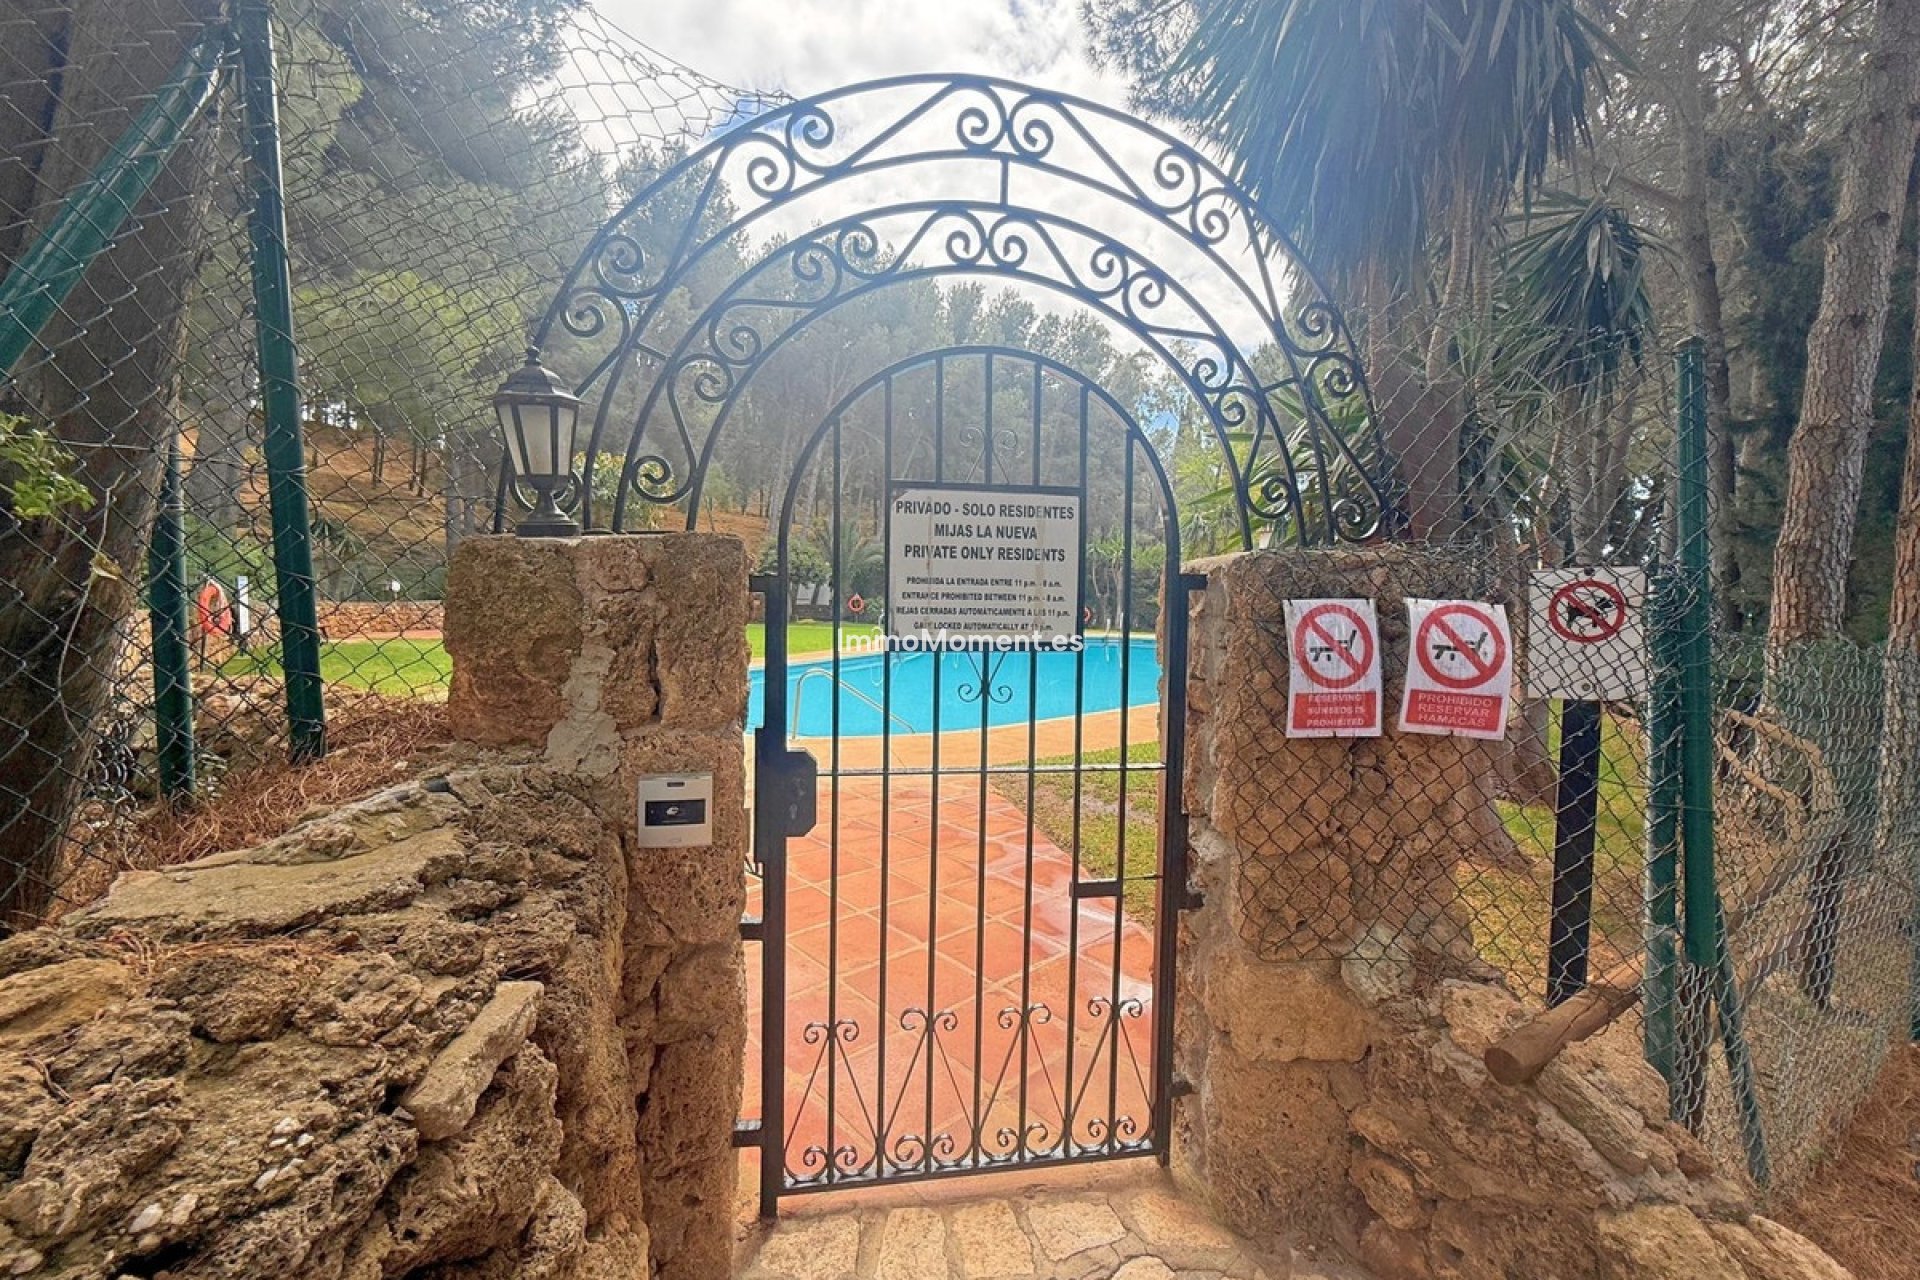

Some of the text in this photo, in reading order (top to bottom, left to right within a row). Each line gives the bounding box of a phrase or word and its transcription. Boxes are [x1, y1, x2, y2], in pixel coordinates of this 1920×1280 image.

[896, 501, 950, 515] PRIVADO
[963, 503, 995, 516] SOLO
[1000, 504, 1074, 519] RESIDENTES
[934, 524, 1037, 540] MIJAS LA NUEVA
[904, 545, 1065, 562] PRIVATE ONLY RESIDENTS
[945, 577, 955, 585] LA
[957, 577, 989, 586] ENTRADA
[990, 578, 1012, 586] ENTRE
[1014, 579, 1021, 587] 11
[940, 592, 982, 601] PROHIBITED
[984, 593, 1016, 601] BETWEEN
[896, 606, 919, 615] REJAS
[920, 607, 957, 615] CERRADAS
[1027, 608, 1032, 616] A
[934, 622, 961, 630] LOCKED
[963, 622, 1019, 631] AUTOMATICALLY
[1021, 623, 1029, 631] AT
[1418, 692, 1492, 708] PROHIBIDO
[1418, 703, 1491, 717] RESERVAR
[1418, 714, 1486, 727] HAMACAS
